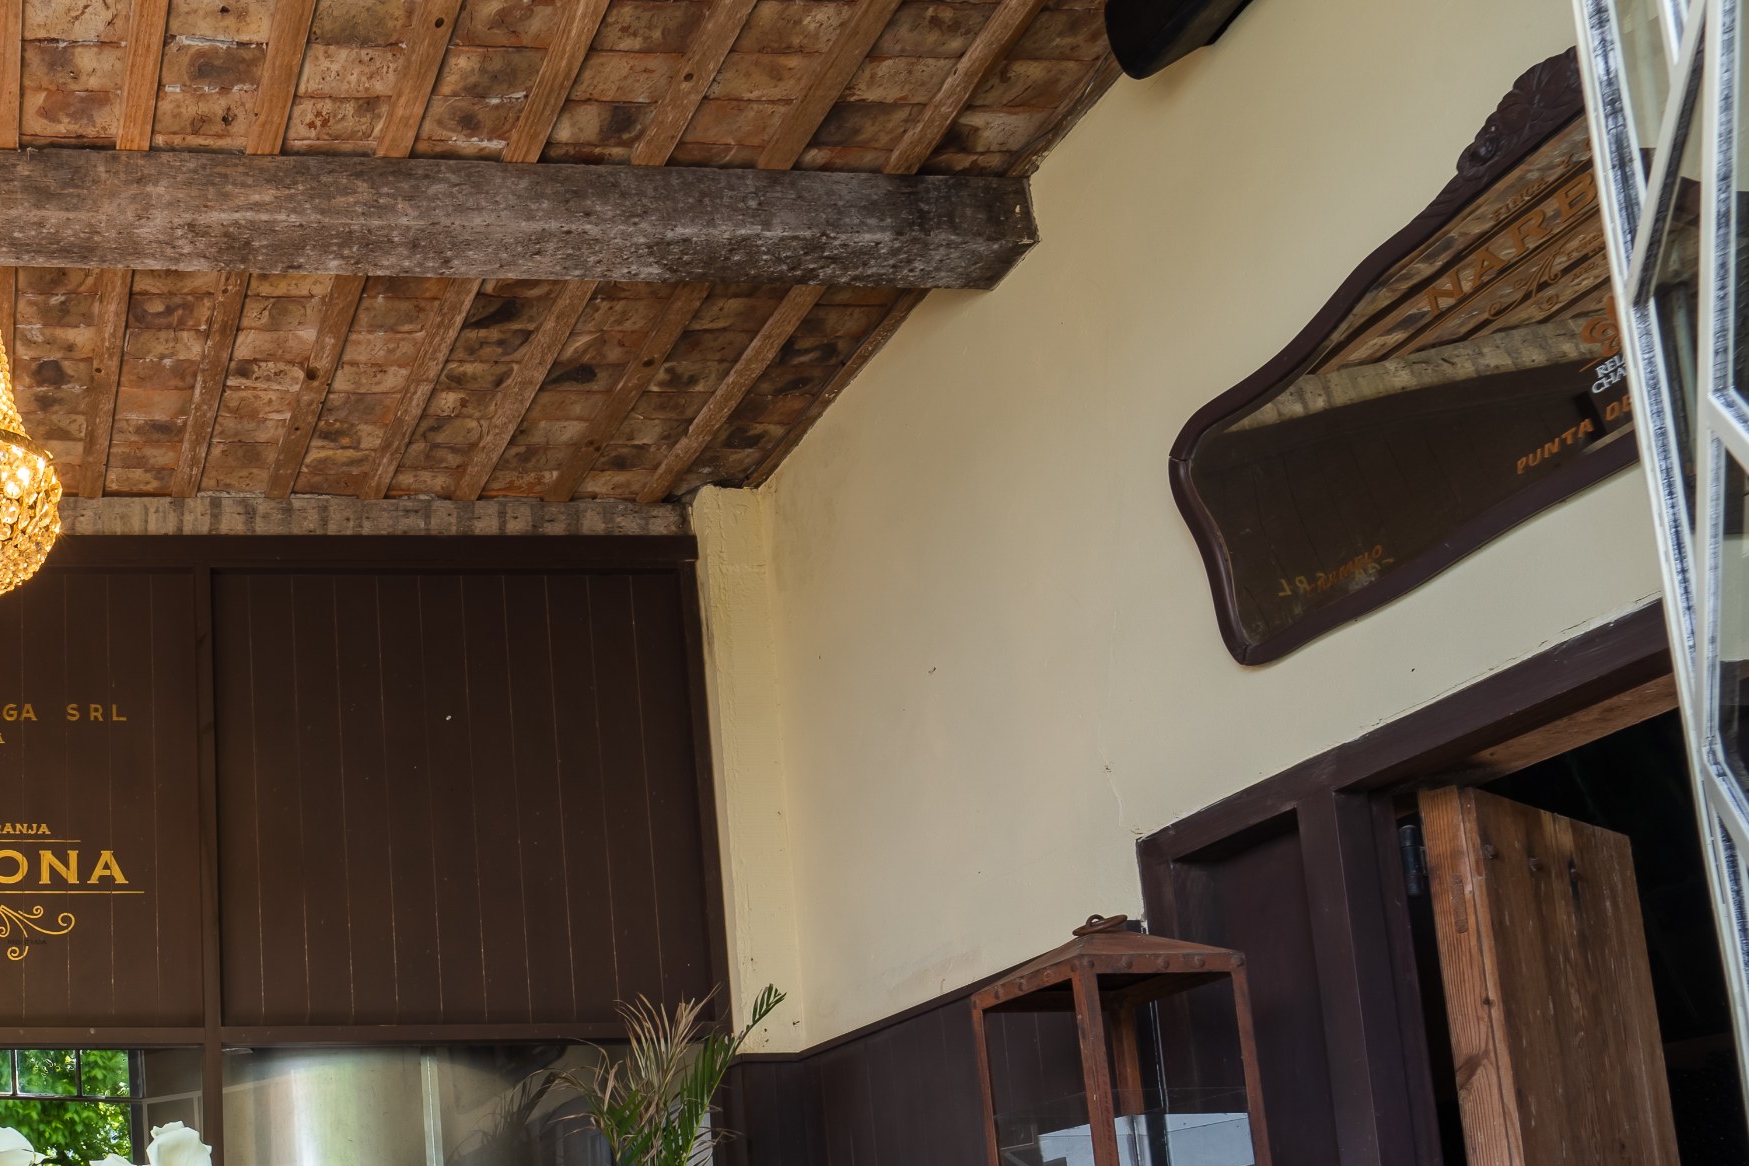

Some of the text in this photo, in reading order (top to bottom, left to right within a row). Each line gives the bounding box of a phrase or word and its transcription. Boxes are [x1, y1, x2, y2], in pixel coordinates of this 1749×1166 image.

[1425, 171, 1598, 316] NARB
[1591, 364, 1628, 394] CHA
[1605, 394, 1632, 421] DE
[1516, 418, 1594, 475] PUNTA
